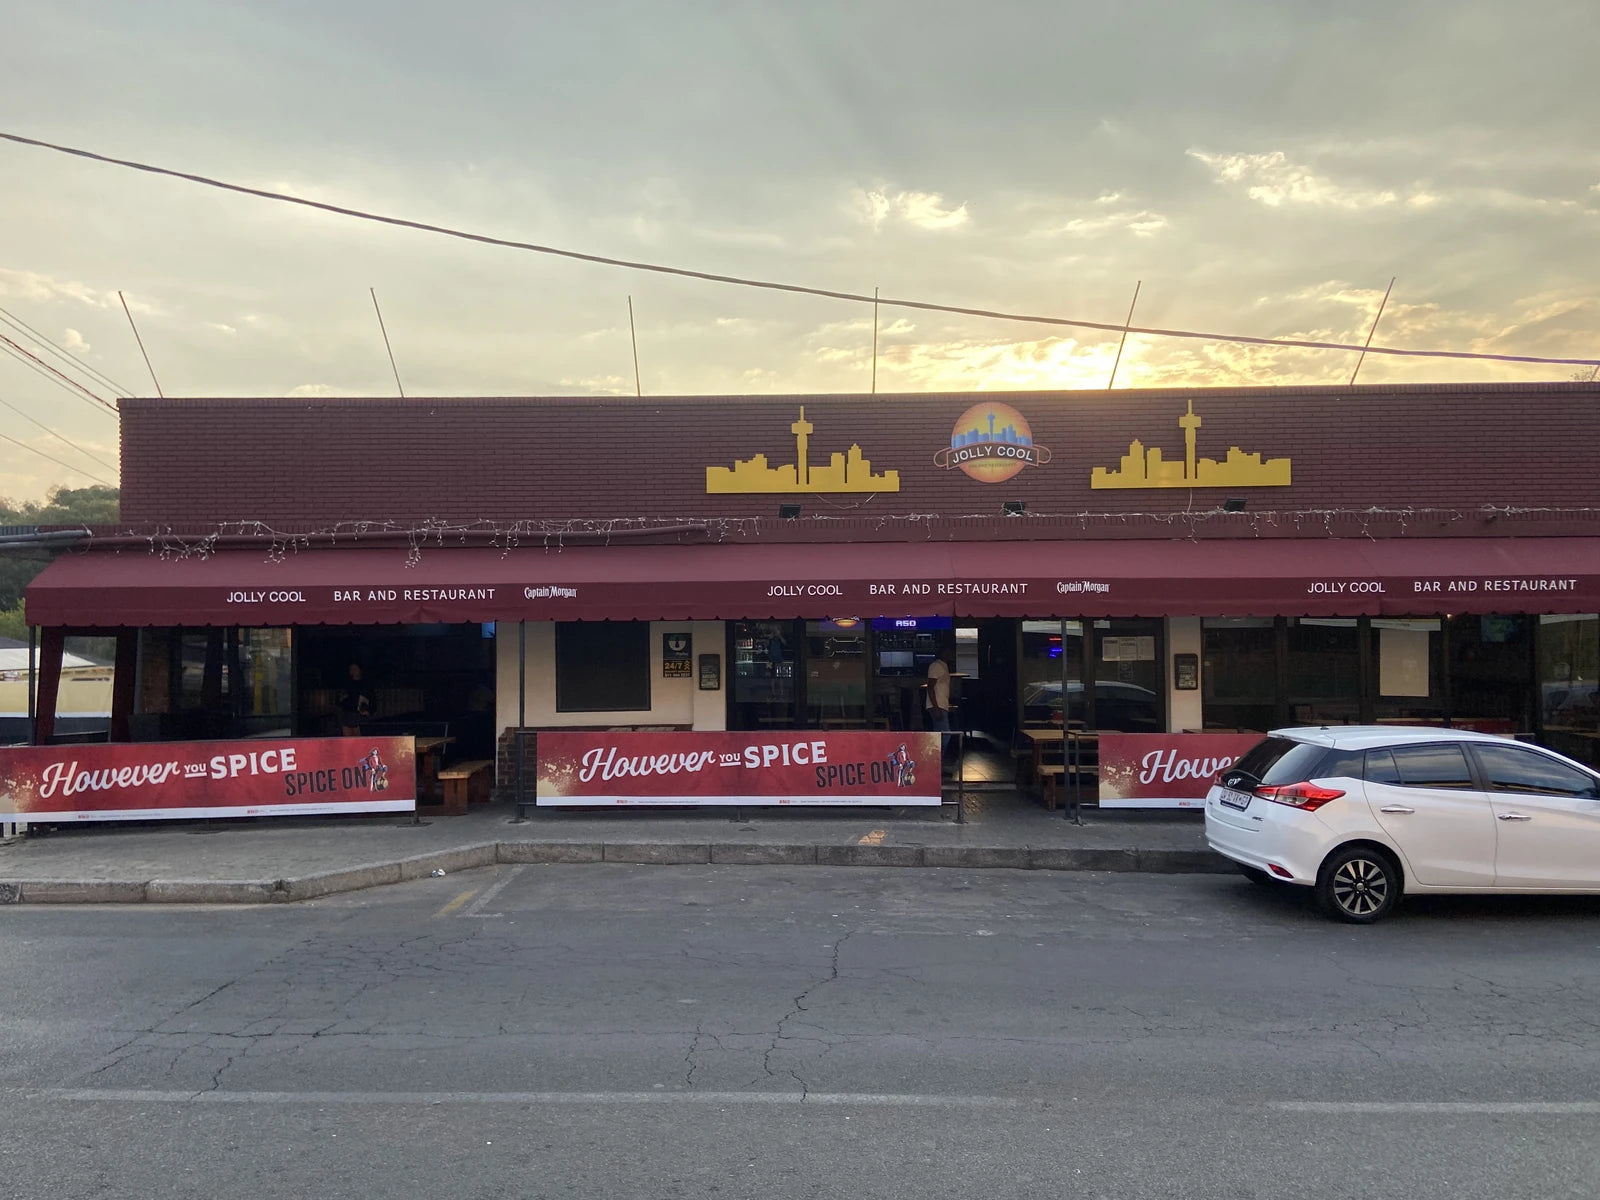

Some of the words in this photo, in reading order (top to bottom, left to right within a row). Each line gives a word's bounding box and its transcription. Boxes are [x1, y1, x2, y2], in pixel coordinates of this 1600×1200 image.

[953, 445, 993, 464] JOLLY
[997, 446, 1033, 461] COOL
[226, 591, 266, 603] JOLLY
[269, 591, 306, 602] COOL
[333, 590, 362, 601] BAR
[367, 590, 397, 601] AND
[403, 588, 495, 601] RESTAURANT
[524, 586, 550, 600] Captain
[549, 585, 577, 600] Morgan
[767, 585, 805, 596] JOLLY
[807, 584, 843, 596] COOL
[869, 584, 896, 595] BAR
[902, 583, 931, 595] AND
[937, 583, 1029, 595] RESTAURANT
[1056, 581, 1082, 595] Captain
[1081, 580, 1110, 594] Morgan
[1307, 582, 1347, 593] JOLLY
[1350, 582, 1386, 593] COOL
[1413, 581, 1442, 592] BAR
[1447, 580, 1478, 592] AND
[1484, 579, 1577, 591] RESTAURANT
[664, 662, 683, 671] 24/7
[40, 760, 180, 798] However
[184, 763, 208, 774] YOU
[210, 748, 298, 780] SPICE
[579, 747, 716, 783] However
[719, 752, 741, 763] YOU
[744, 741, 828, 769] SPICE
[1140, 749, 1240, 785] Howe
[284, 770, 338, 797] SPICE
[342, 766, 369, 790] ON
[815, 764, 866, 788] SPICE
[870, 761, 897, 783] ON
